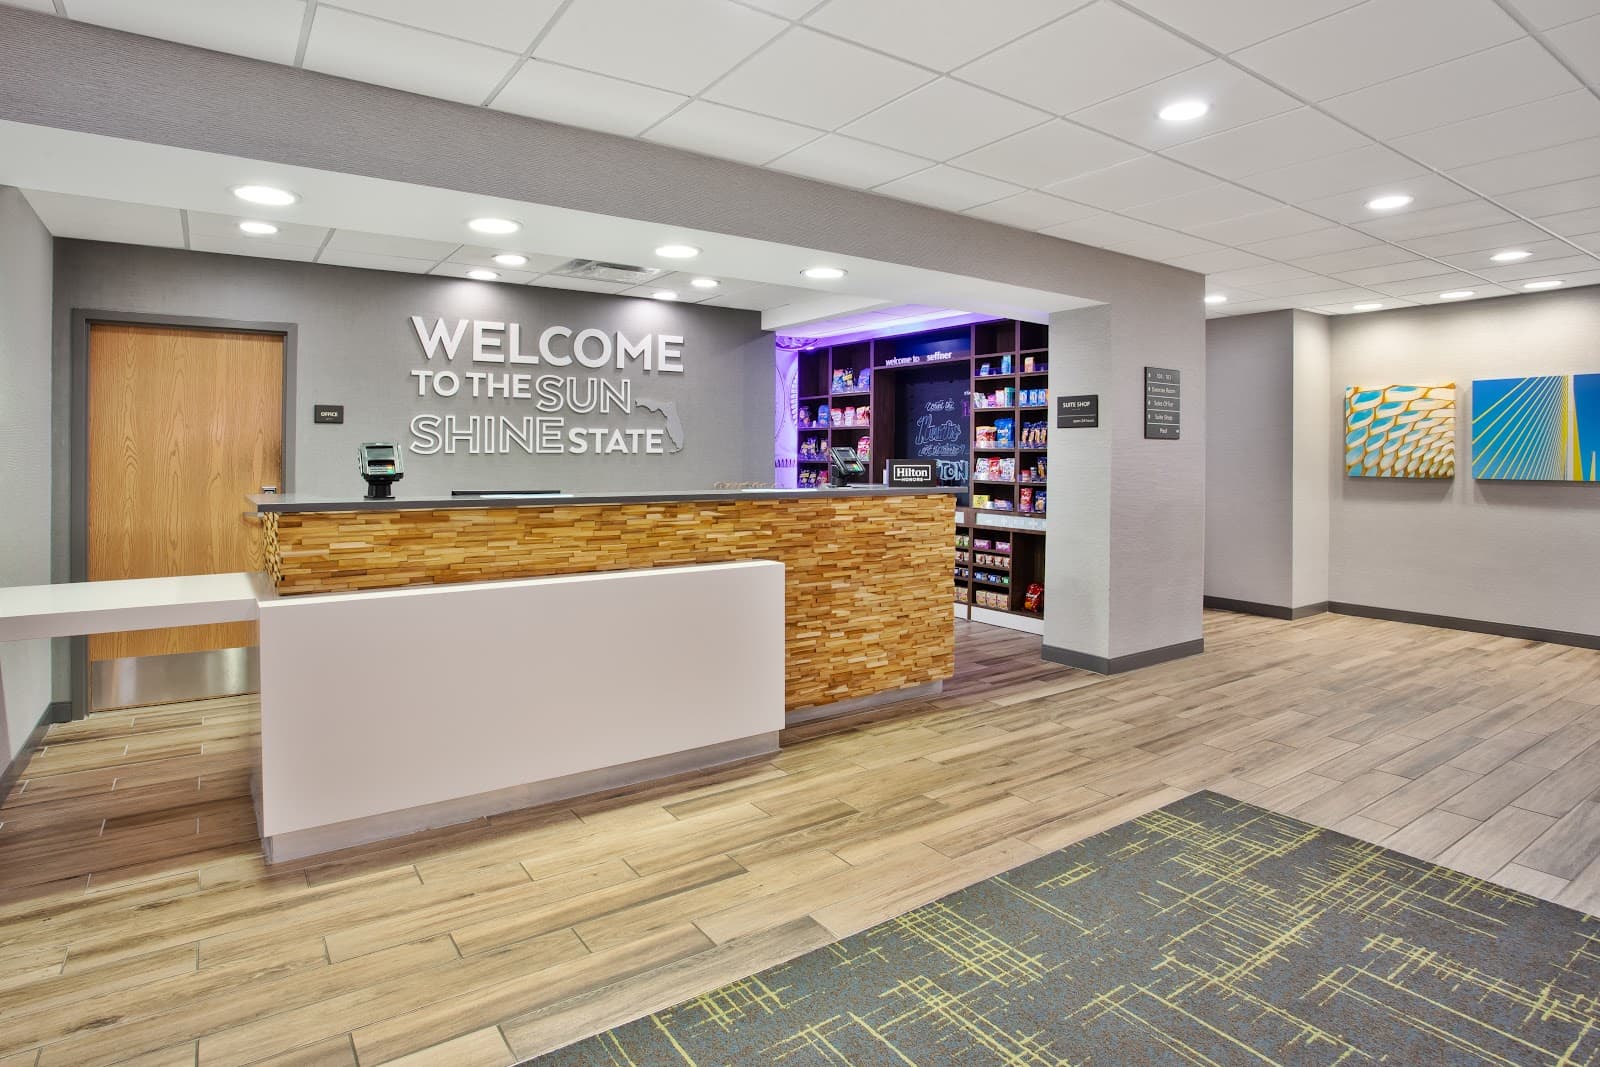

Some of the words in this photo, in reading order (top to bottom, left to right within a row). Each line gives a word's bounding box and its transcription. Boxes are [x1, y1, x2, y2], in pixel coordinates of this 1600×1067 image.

[410, 315, 684, 373] WELCOME
[885, 356, 912, 366] welcome
[912, 354, 920, 363] to
[411, 369, 459, 397] TO
[466, 372, 531, 399] THE
[536, 374, 631, 414] SUN
[410, 413, 565, 455] SHINE
[567, 426, 665, 455] STATE
[896, 467, 928, 477] Hilton
